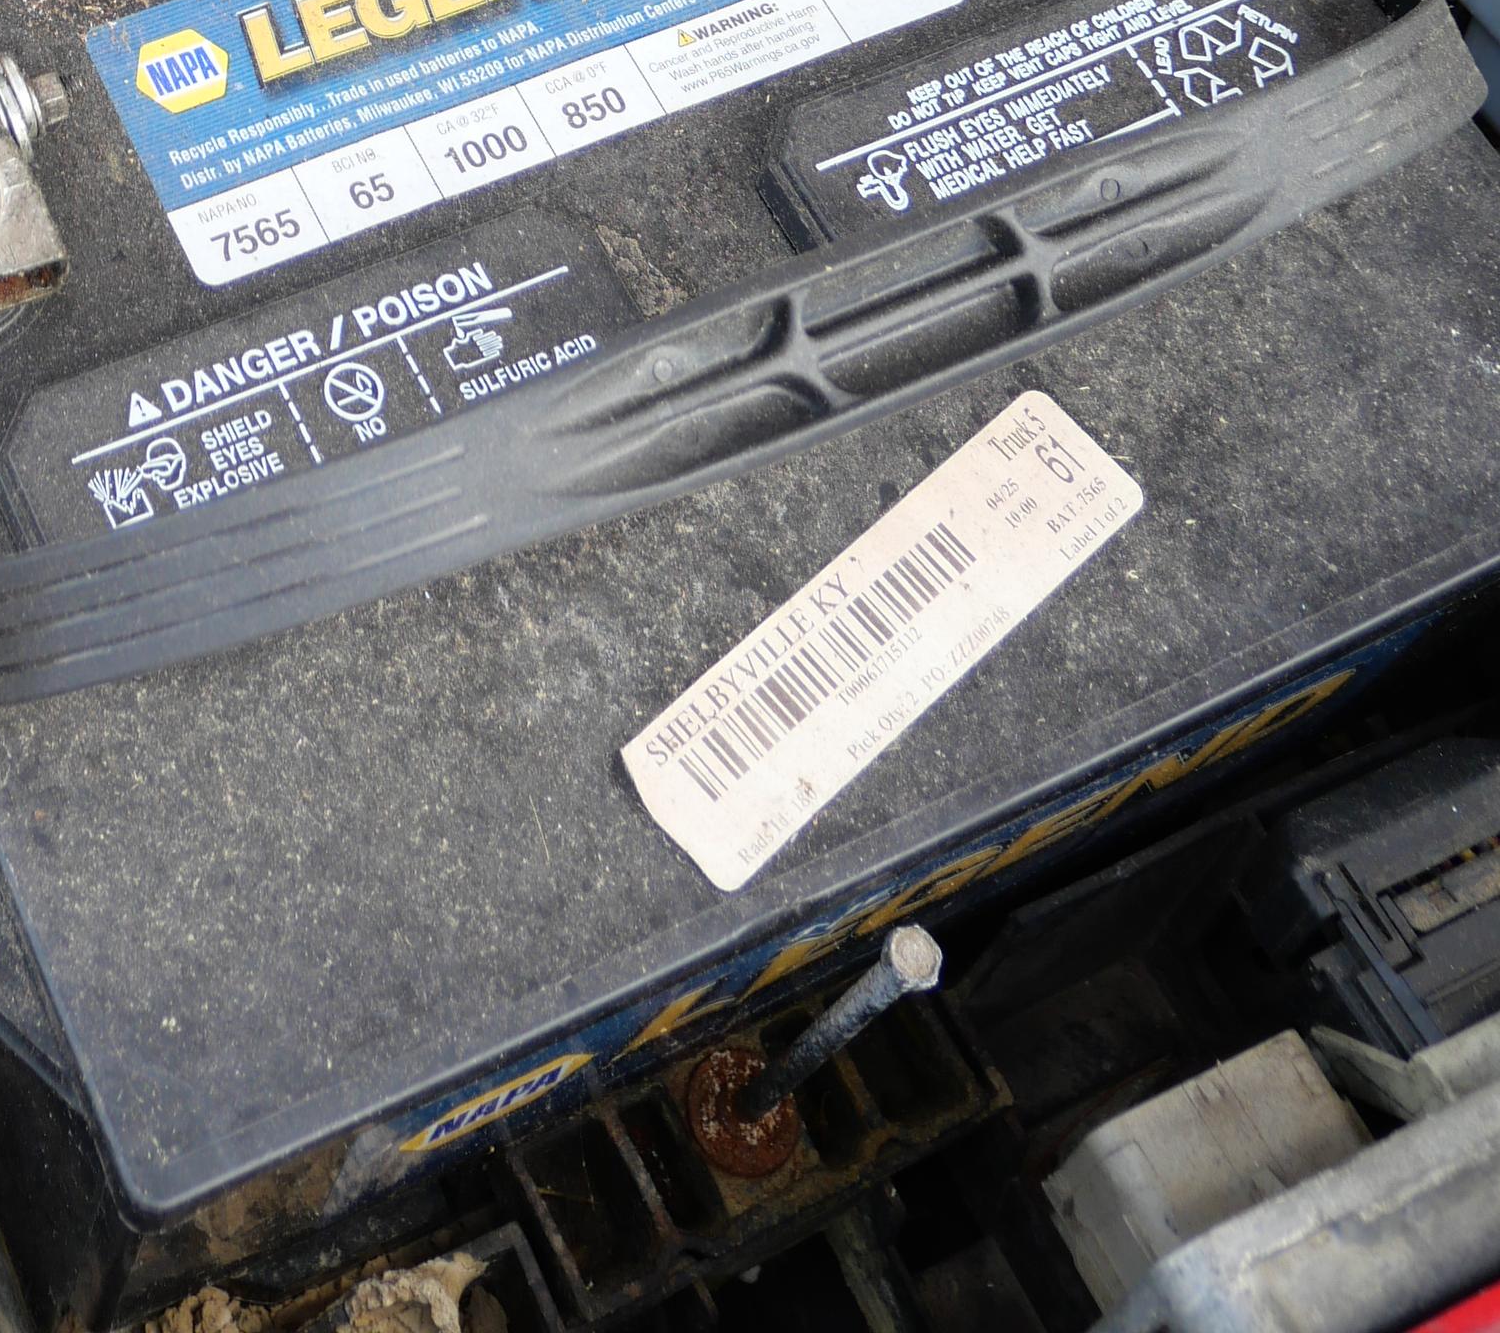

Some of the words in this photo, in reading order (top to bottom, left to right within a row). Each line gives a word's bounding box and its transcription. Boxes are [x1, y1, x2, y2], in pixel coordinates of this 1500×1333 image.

[648, 53, 690, 74] Cancer
[691, 43, 713, 59] and
[714, 16, 787, 49] Reproductive
[787, 3, 818, 22] Harm
[692, 2, 780, 40] WARNING:
[1237, 4, 1298, 44] RETURN
[146, 46, 220, 96] NAPA
[668, 62, 702, 82] Wash
[703, 50, 739, 68] hands
[741, 40, 765, 56] after
[888, 112, 913, 130] DO
[912, 100, 939, 120] NOT
[945, 89, 965, 108] TIP
[971, 72, 1008, 96] KEEP
[1007, 56, 1047, 84] VENT
[1047, 44, 1083, 67] CAPS
[1083, 27, 1129, 55] TIGHT
[1125, 15, 1154, 35] AND
[906, 79, 943, 103] KEEP
[945, 68, 973, 87] OUT
[974, 59, 995, 77] OF
[997, 47, 1026, 68] THE
[1023, 29, 1071, 60] REACH
[1070, 20, 1091, 37] OF
[1154, 36, 1173, 76] LEAD
[168, 134, 227, 166] Recycle
[370, 76, 384, 91] in
[385, 66, 417, 86] used
[418, 42, 482, 75] batteries
[482, 38, 498, 53] to
[497, 20, 544, 45] NAPA.
[180, 164, 223, 190] Distr.
[223, 157, 242, 175] by
[242, 140, 288, 167] NAPA
[285, 115, 358, 151] Batteries,
[356, 82, 439, 123] Milwaukee,
[505, 53, 526, 70] for
[524, 38, 567, 61] NAPA
[566, 9, 645, 43] Distribution
[545, 76, 573, 96] CCA
[572, 70, 586, 83] @
[561, 87, 626, 129] 850
[436, 119, 455, 136] CA
[455, 113, 470, 127] @
[902, 124, 964, 163] FLUSH
[962, 106, 1007, 137] EYES
[1004, 64, 1112, 118] IMMEDIATELY
[332, 154, 355, 174] BCI
[444, 125, 528, 173] 1000
[915, 148, 964, 180] WITH
[961, 125, 1027, 161] WATER.
[1026, 107, 1062, 135] GET
[928, 157, 1006, 201] MEDICAL
[1005, 140, 1047, 171] HELP
[1046, 119, 1095, 153] FAST
[197, 199, 235, 225] NAPA
[349, 172, 395, 209] 65
[210, 208, 301, 262] 7565
[161, 329, 321, 413] DANGER
[351, 262, 493, 338] POISON
[459, 353, 552, 401] SULFURIC
[554, 334, 597, 366] ACID
[201, 409, 272, 451] SHIELD
[210, 436, 264, 472] EYES
[353, 417, 387, 442] NO
[987, 413, 1040, 463] Truck
[173, 452, 284, 510] EXPLOSIVE
[1034, 434, 1086, 483] 61
[985, 478, 1020, 511] 04/25
[1004, 496, 1038, 530] 10:00
[1059, 524, 1098, 562] Label
[1104, 502, 1122, 522] of
[1115, 496, 1128, 512] 2
[645, 606, 816, 768] SHELBYVILLE
[808, 572, 852, 618] KY
[845, 729, 882, 763] Pick
[907, 691, 920, 709] 2
[610, 668, 1360, 1066] LEGEND
[428, 1066, 564, 1142] NAPA
